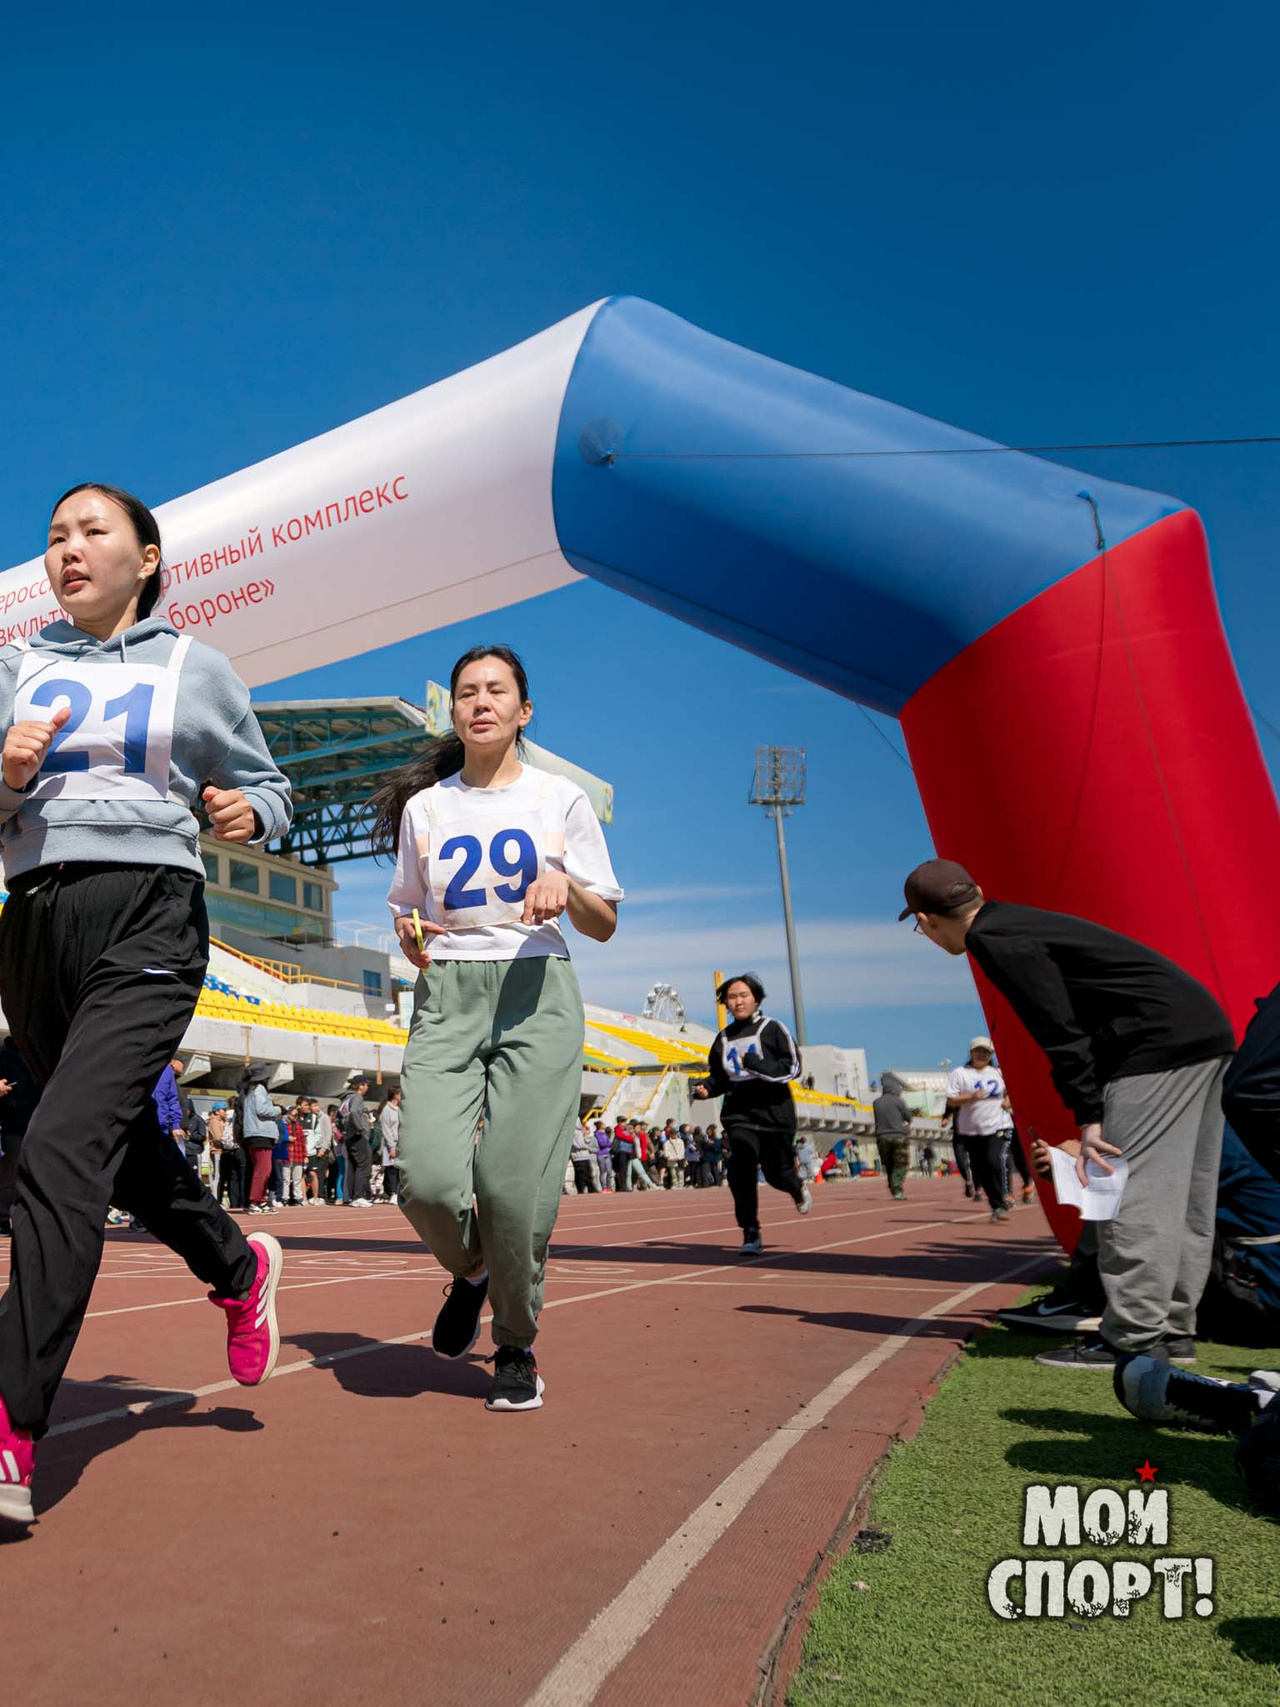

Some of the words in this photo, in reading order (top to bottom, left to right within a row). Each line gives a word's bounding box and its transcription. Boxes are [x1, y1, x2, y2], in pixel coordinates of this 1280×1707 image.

[271, 476, 409, 547] комплекс
[159, 578, 276, 630] бороне»
[30, 678, 155, 773] 21
[438, 828, 538, 911] 29
[727, 1043, 757, 1076] 1
